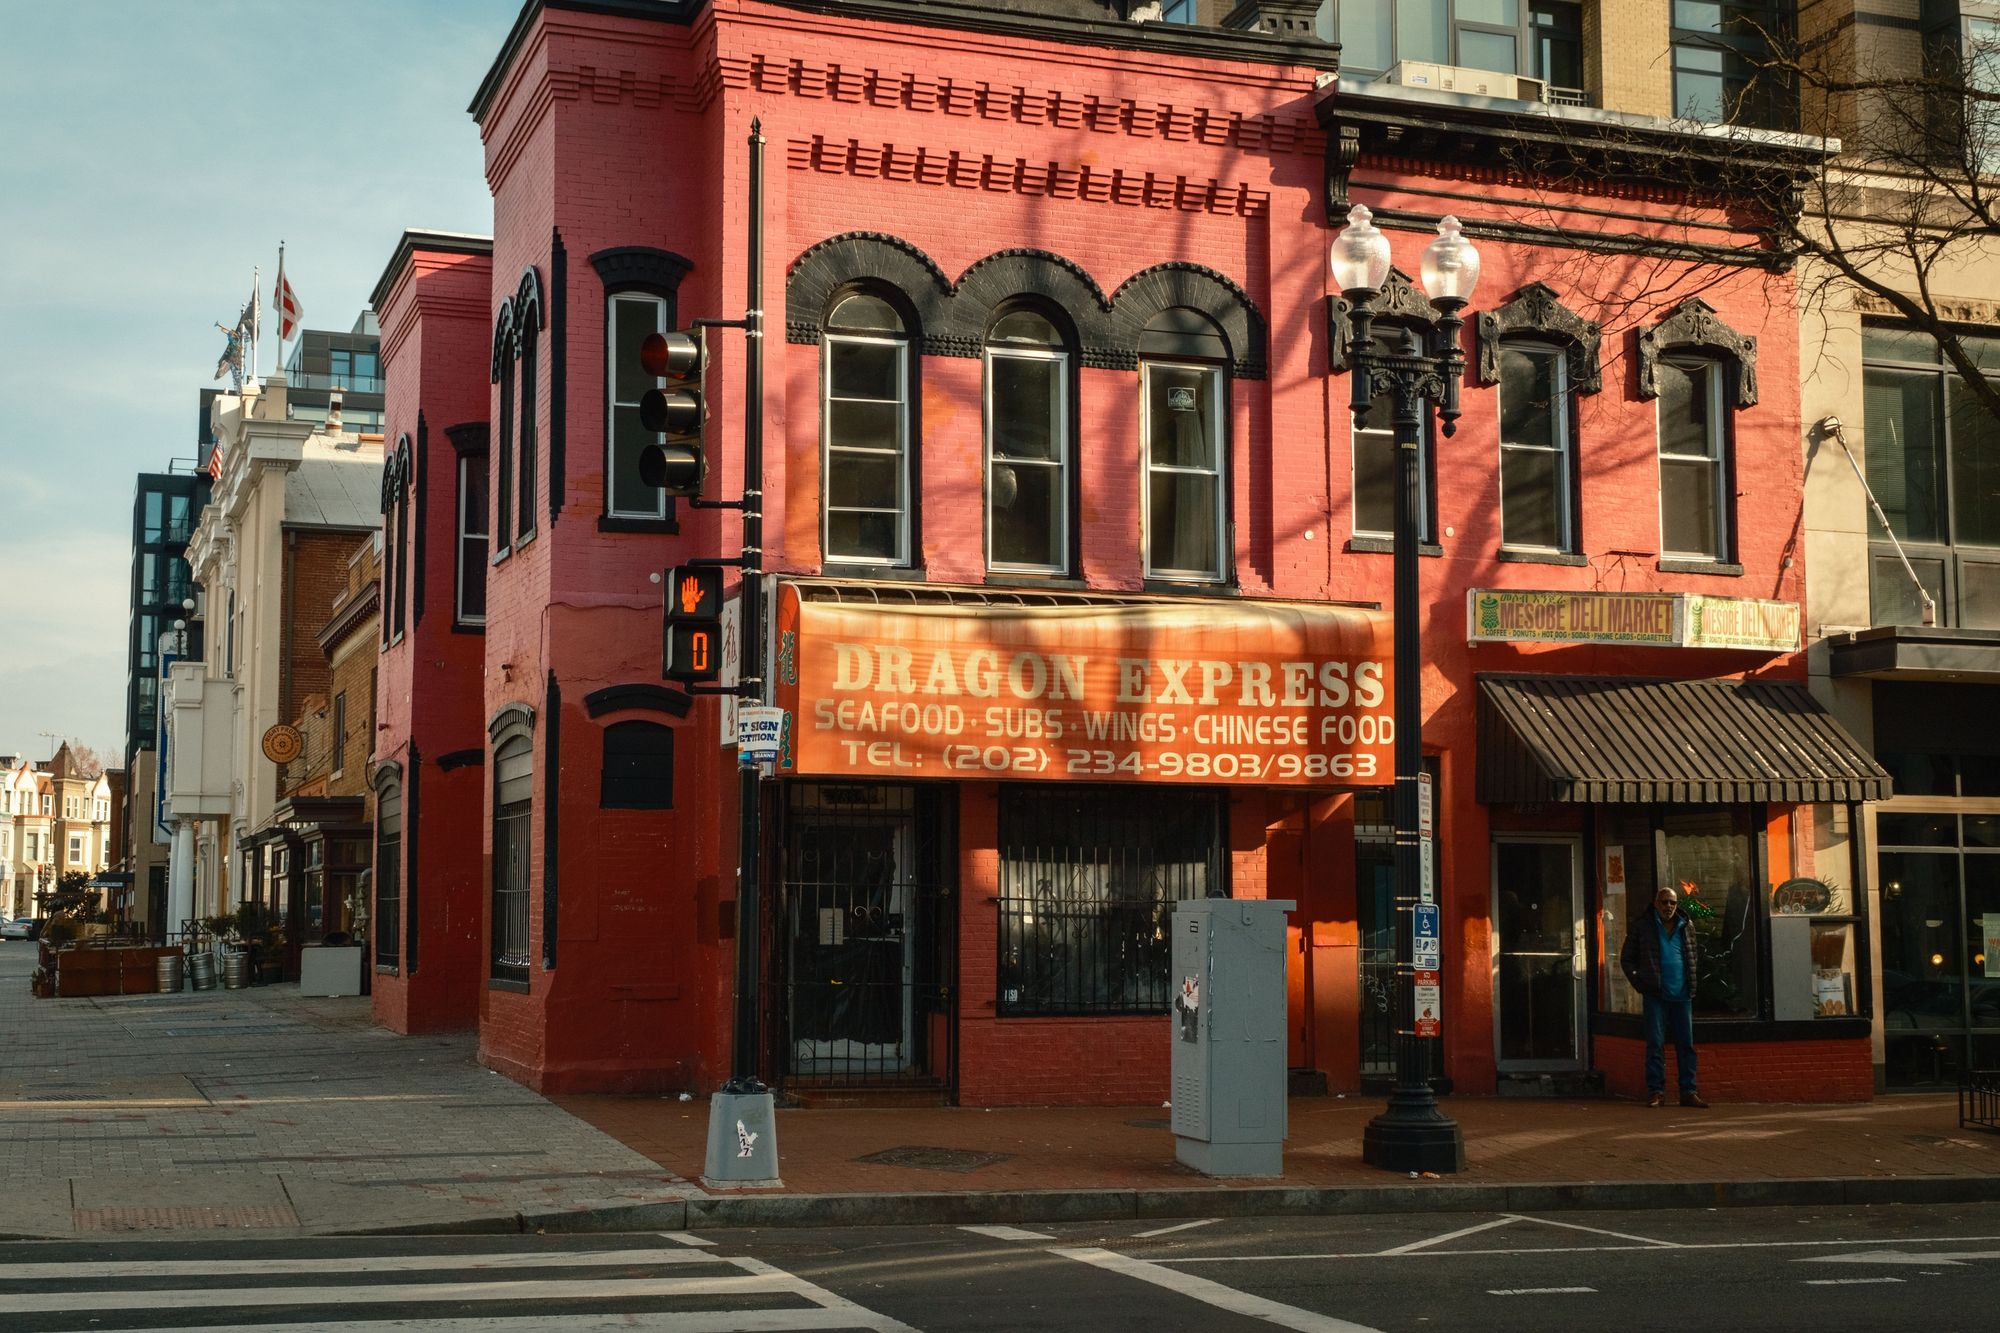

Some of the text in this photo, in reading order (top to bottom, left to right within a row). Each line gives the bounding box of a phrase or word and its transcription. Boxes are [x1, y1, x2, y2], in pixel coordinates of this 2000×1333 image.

[1500, 596, 1673, 634] MESOBE DELI MARKET
[1702, 603, 1797, 640] MESOBE DELI MARKET
[692, 632, 708, 671] 0
[1485, 629, 1507, 637] COFFEE
[1513, 630, 1536, 638] DONUTS
[1542, 630, 1554, 638] HOT
[1571, 631, 1590, 639] SODAS
[1594, 632, 1613, 640] PHONE
[1637, 633, 1673, 642] CIGARETTES
[832, 642, 1385, 708] DRAGON EXPRESS
[751, 721, 779, 731] SIGN
[815, 698, 1395, 744] SEAFOOD SUBS WINGS CHINESE FOOD
[841, 739, 1377, 778] TEL: (202) 234-9803/9863
